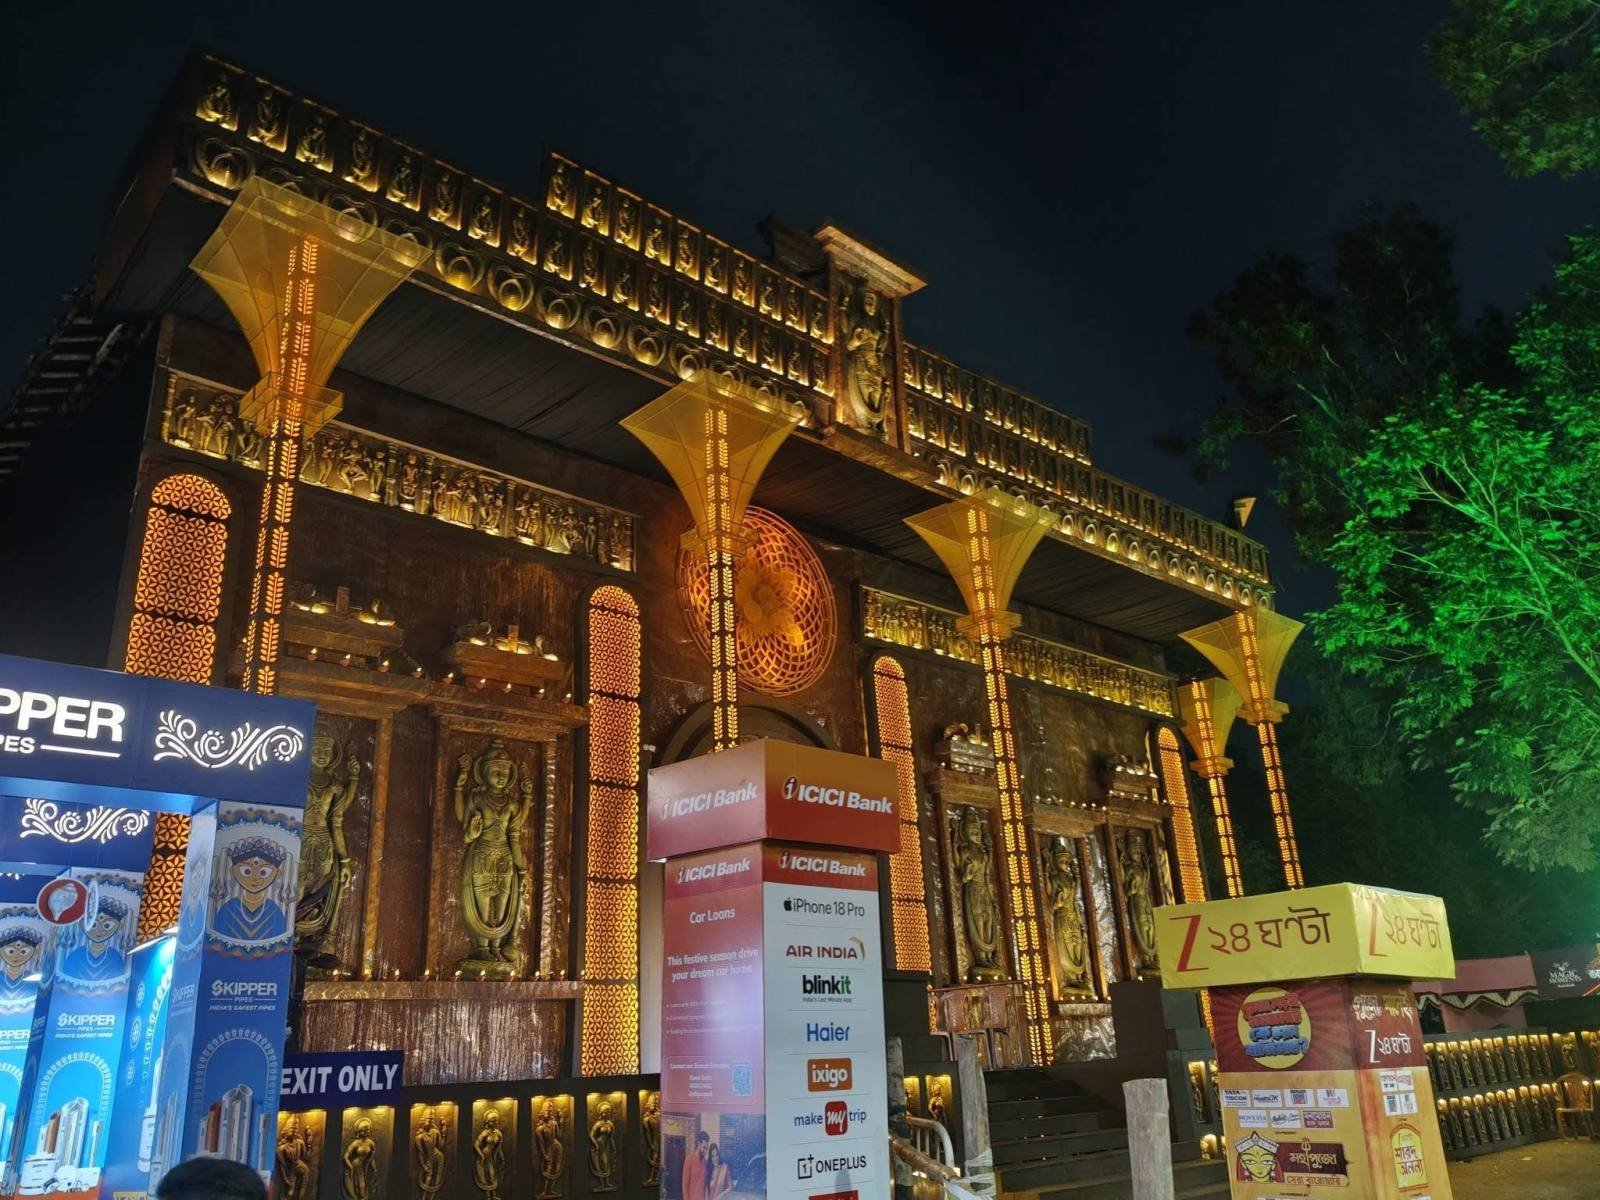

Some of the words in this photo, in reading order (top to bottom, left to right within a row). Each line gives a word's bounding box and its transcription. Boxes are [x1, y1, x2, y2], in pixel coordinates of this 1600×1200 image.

[672, 792, 712, 818] ICICI
[714, 782, 758, 808] Bank
[798, 785, 845, 807] ICICI
[847, 791, 893, 814] Bank
[685, 864, 716, 882] ICICI
[717, 858, 751, 876] Bank
[790, 856, 827, 872] ICICI
[829, 861, 867, 876] Bank
[689, 911, 706, 924] Car
[707, 908, 736, 921] Loans
[793, 899, 832, 914] iPhone
[834, 901, 846, 916] 18
[848, 902, 865, 917] Pro
[786, 945, 812, 957] AIR
[817, 946, 858, 959] INDIA
[1169, 914, 1210, 972] Z
[1207, 923, 1250, 955] ২৪
[667, 956, 682, 966] This
[684, 953, 708, 965] festive
[710, 951, 736, 962] season
[738, 947, 760, 959] drive
[672, 971, 688, 983] your
[690, 968, 714, 979] dream
[716, 967, 728, 976] car
[802, 974, 851, 994] blinkit
[211, 980, 277, 996] SKIPPER
[57, 1013, 115, 1027] SKIPPER
[806, 1022, 850, 1042] Haier
[280, 1066, 332, 1095] EXIT
[338, 1064, 399, 1092] ONLY
[812, 1063, 848, 1087] ixigo
[794, 1113, 823, 1126] make
[827, 1110, 847, 1133] my
[849, 1108, 867, 1125] trip
[815, 1155, 867, 1173] ONEPLUS
